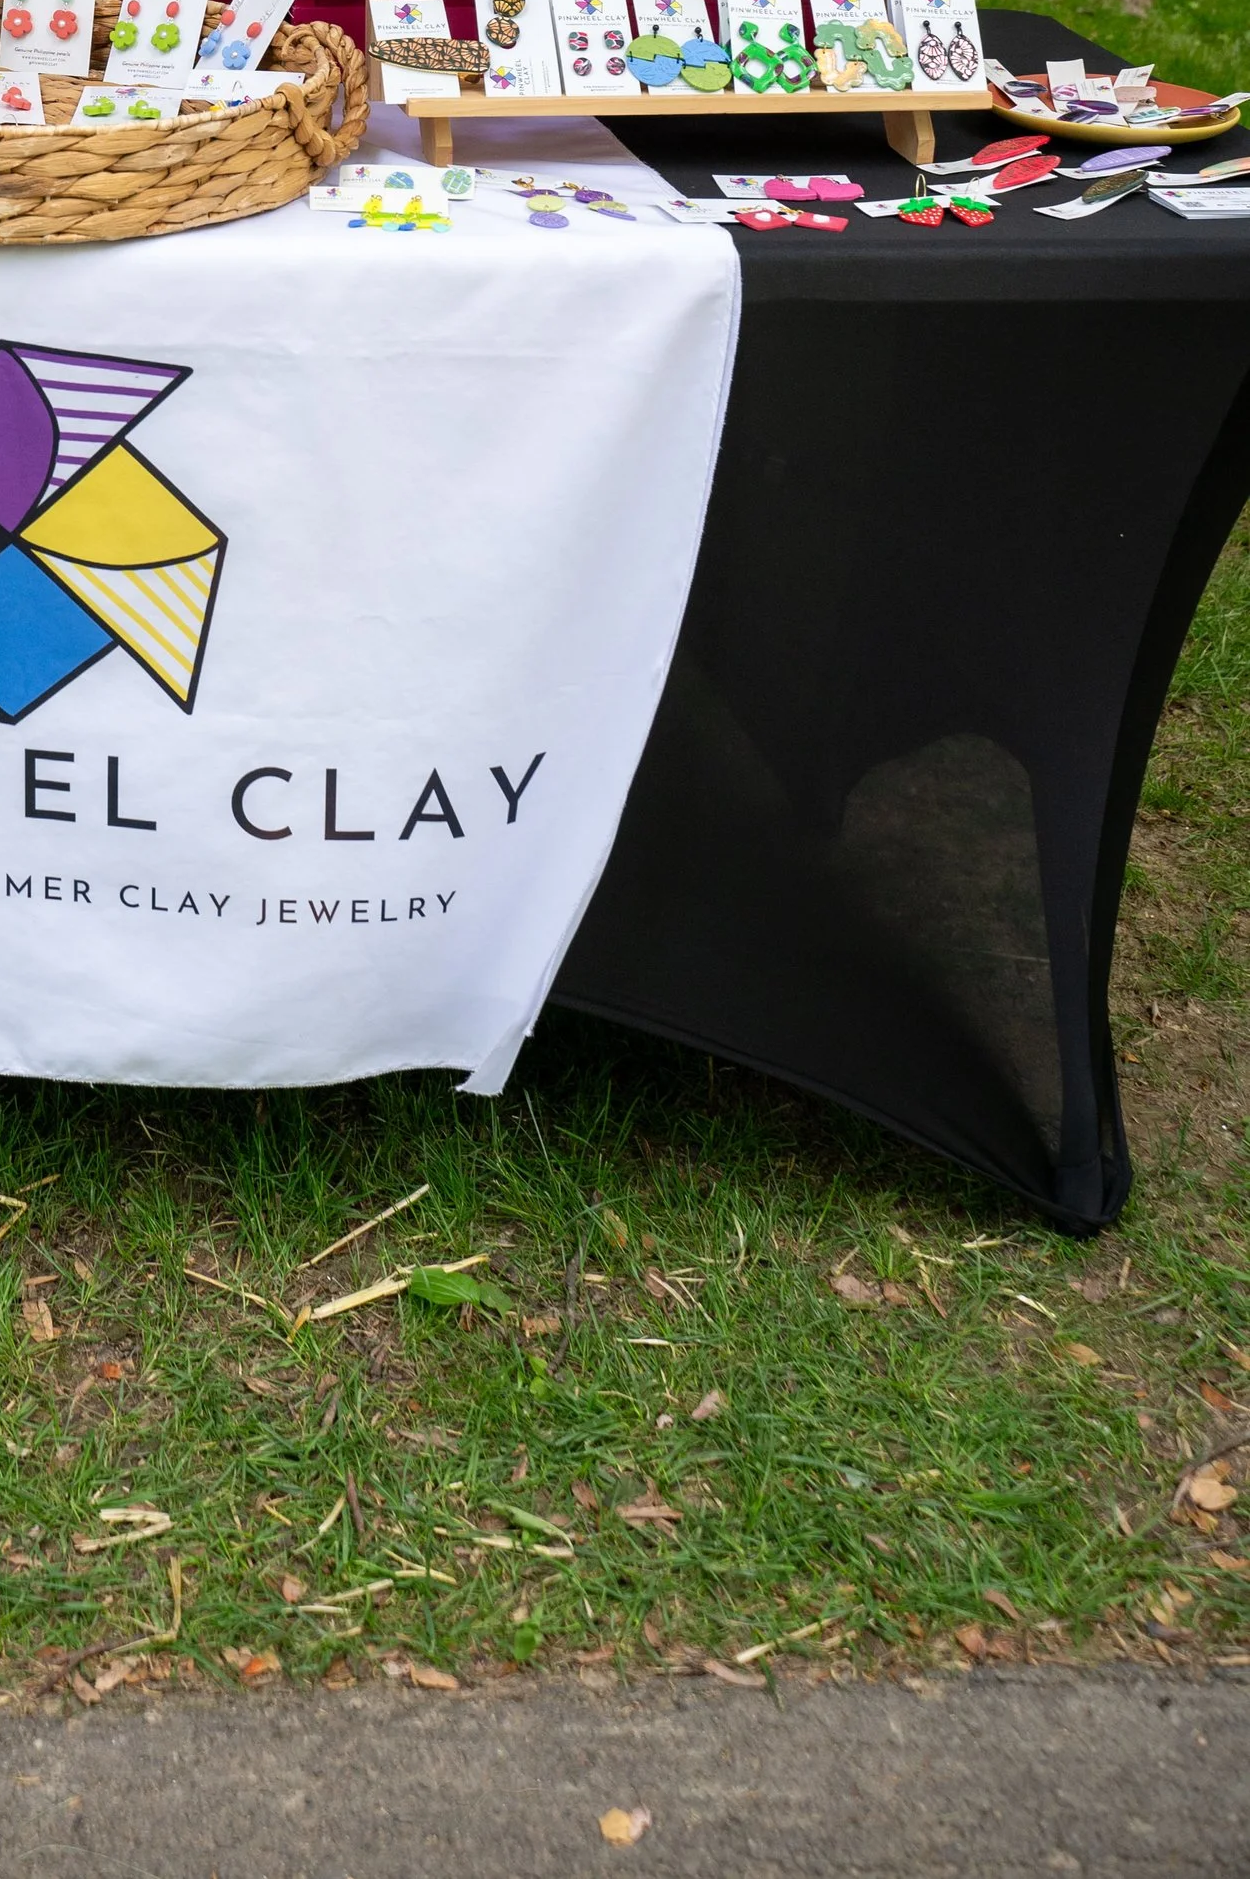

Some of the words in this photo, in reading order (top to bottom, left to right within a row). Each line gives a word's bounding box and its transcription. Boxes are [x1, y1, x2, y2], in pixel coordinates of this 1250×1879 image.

[730, 7, 773, 15] PINWHEEL
[906, 6, 950, 14] PINWHEEL
[816, 11, 859, 19] PINWHEEL
[685, 17, 705, 25] CLAY
[377, 23, 422, 31] PINWHEEL
[231, 751, 546, 841] CLAY
[119, 884, 230, 918] CLAY
[256, 890, 457, 926] JEWELRY
